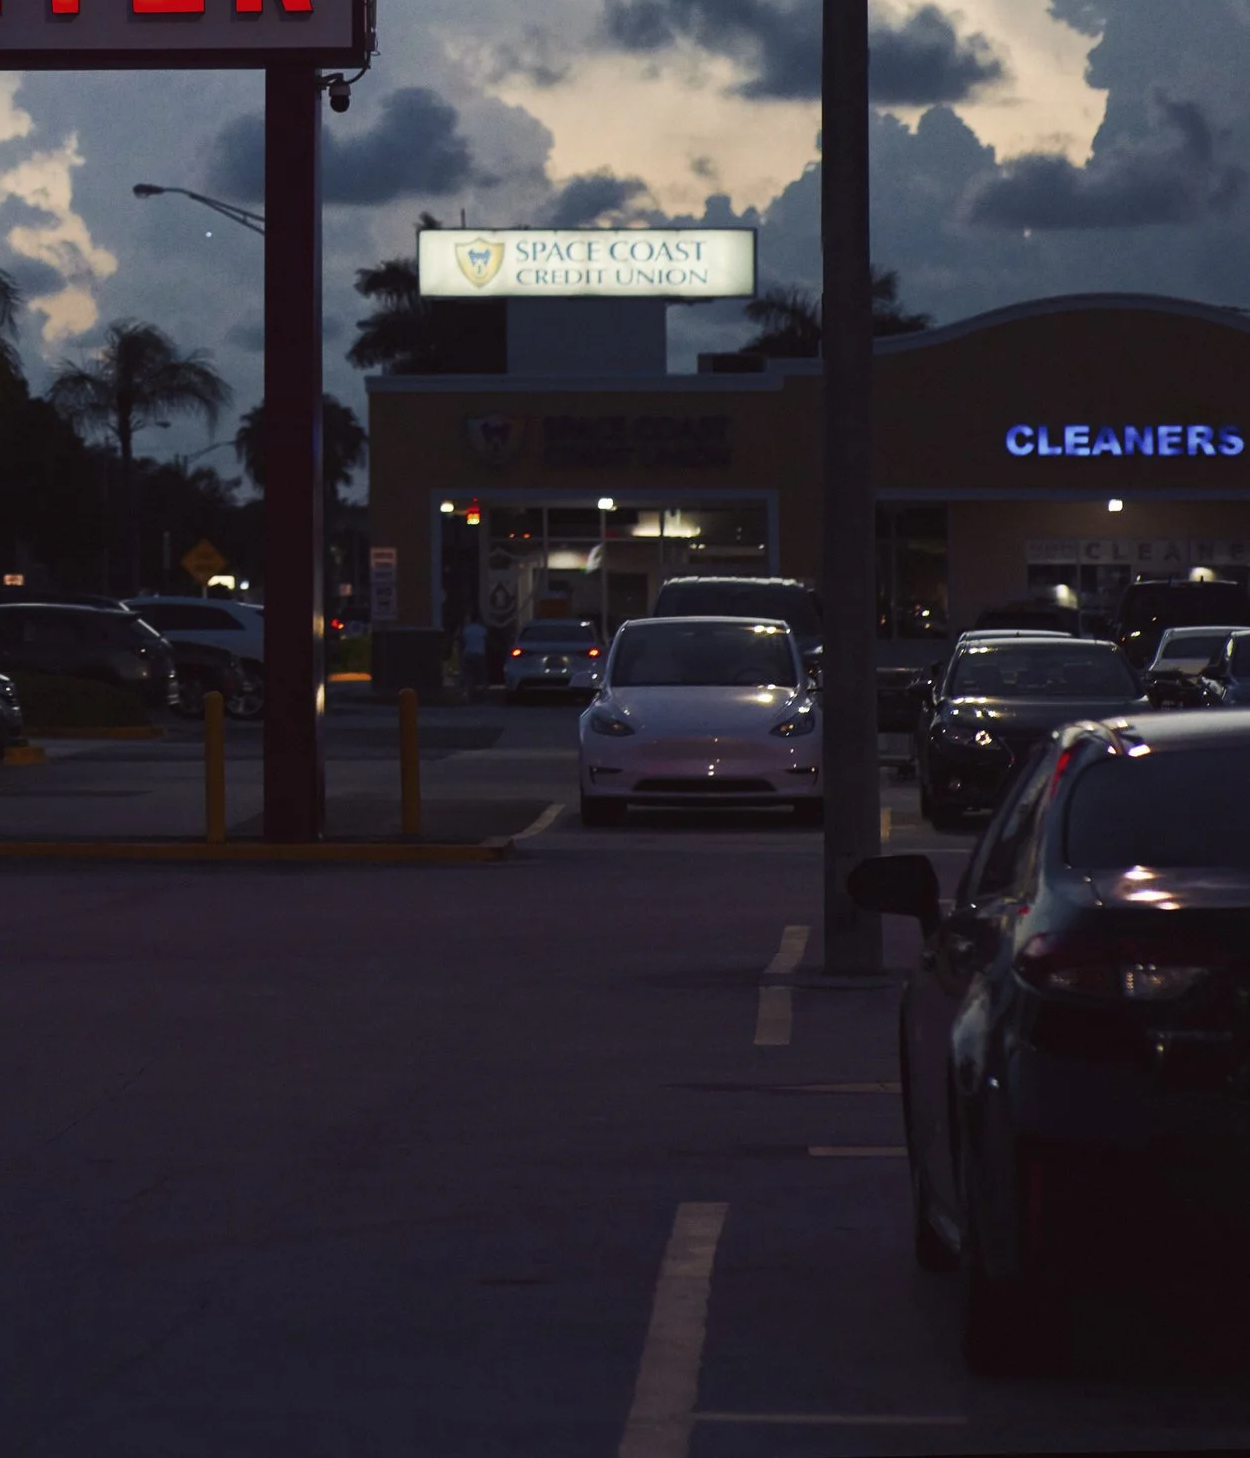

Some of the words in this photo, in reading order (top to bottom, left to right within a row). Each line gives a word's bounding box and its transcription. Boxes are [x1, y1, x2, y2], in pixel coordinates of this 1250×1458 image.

[515, 240, 601, 263] SPACE
[609, 240, 707, 263] COAST
[515, 268, 608, 285] CREDIT
[615, 268, 708, 285] UNION
[1004, 422, 1246, 458] CLEANERS
